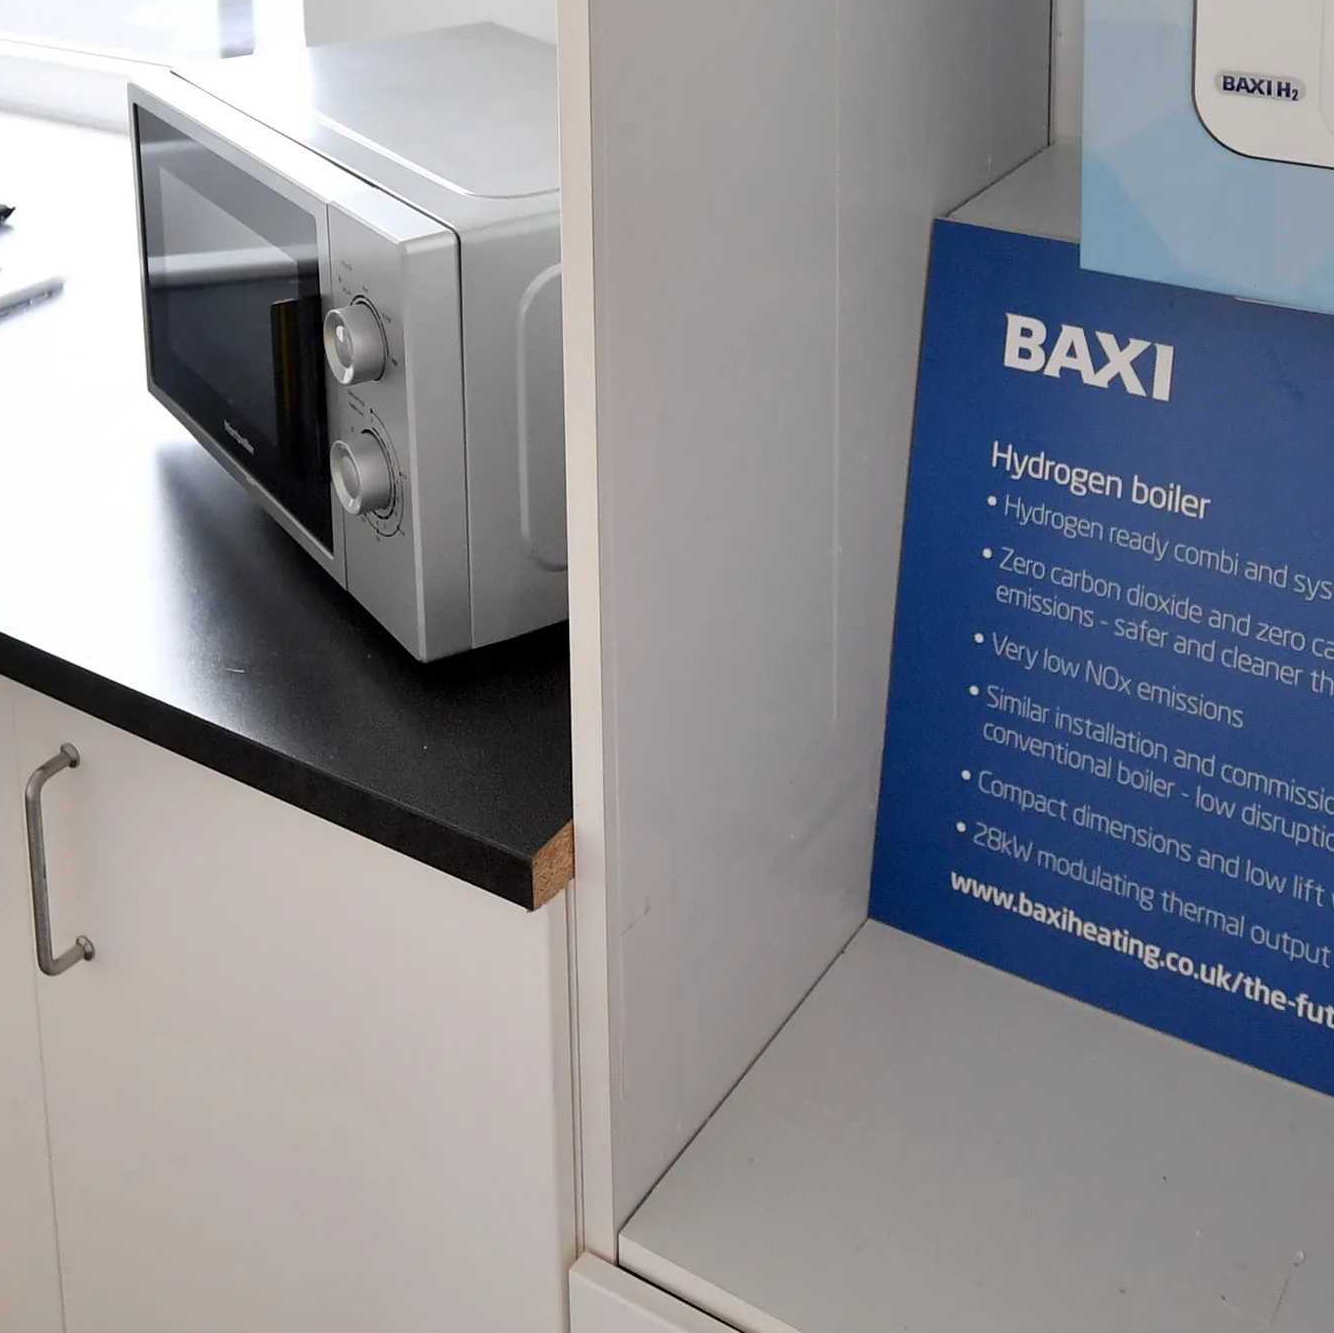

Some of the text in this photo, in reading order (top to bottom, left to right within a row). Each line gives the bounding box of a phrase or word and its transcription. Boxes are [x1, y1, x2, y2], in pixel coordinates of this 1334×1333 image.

[1222, 74, 1273, 97] BAXI
[1003, 312, 1174, 402] BAXI
[991, 440, 1211, 520] Hydrogen boiler
[1004, 493, 1104, 541] Hydrogen
[1109, 526, 1170, 562] ready
[1173, 543, 1239, 576] combi
[1244, 561, 1288, 589] and
[995, 584, 1094, 628] emissions
[1113, 618, 1169, 648] safer
[1173, 635, 1216, 663] and
[1220, 646, 1304, 686] cleaner
[999, 546, 1046, 580] Zero
[1050, 566, 1121, 601] carbon
[1126, 583, 1203, 624] dioxide
[1208, 609, 1251, 637] and
[1255, 621, 1306, 652] zero
[992, 631, 1244, 729] Very low NOx emissions
[982, 722, 1112, 779] conventional
[1116, 760, 1176, 799] boiler
[1195, 785, 1237, 819] low
[986, 684, 1051, 724] Similar
[1054, 706, 1168, 763] installation
[1173, 748, 1216, 778] and
[977, 769, 1068, 822] Compact
[1072, 804, 1192, 863] dimensions
[1196, 848, 1240, 879] and
[1245, 858, 1287, 894] low
[1292, 874, 1325, 908] lift
[972, 821, 1332, 969] 28kW modulating thermal output
